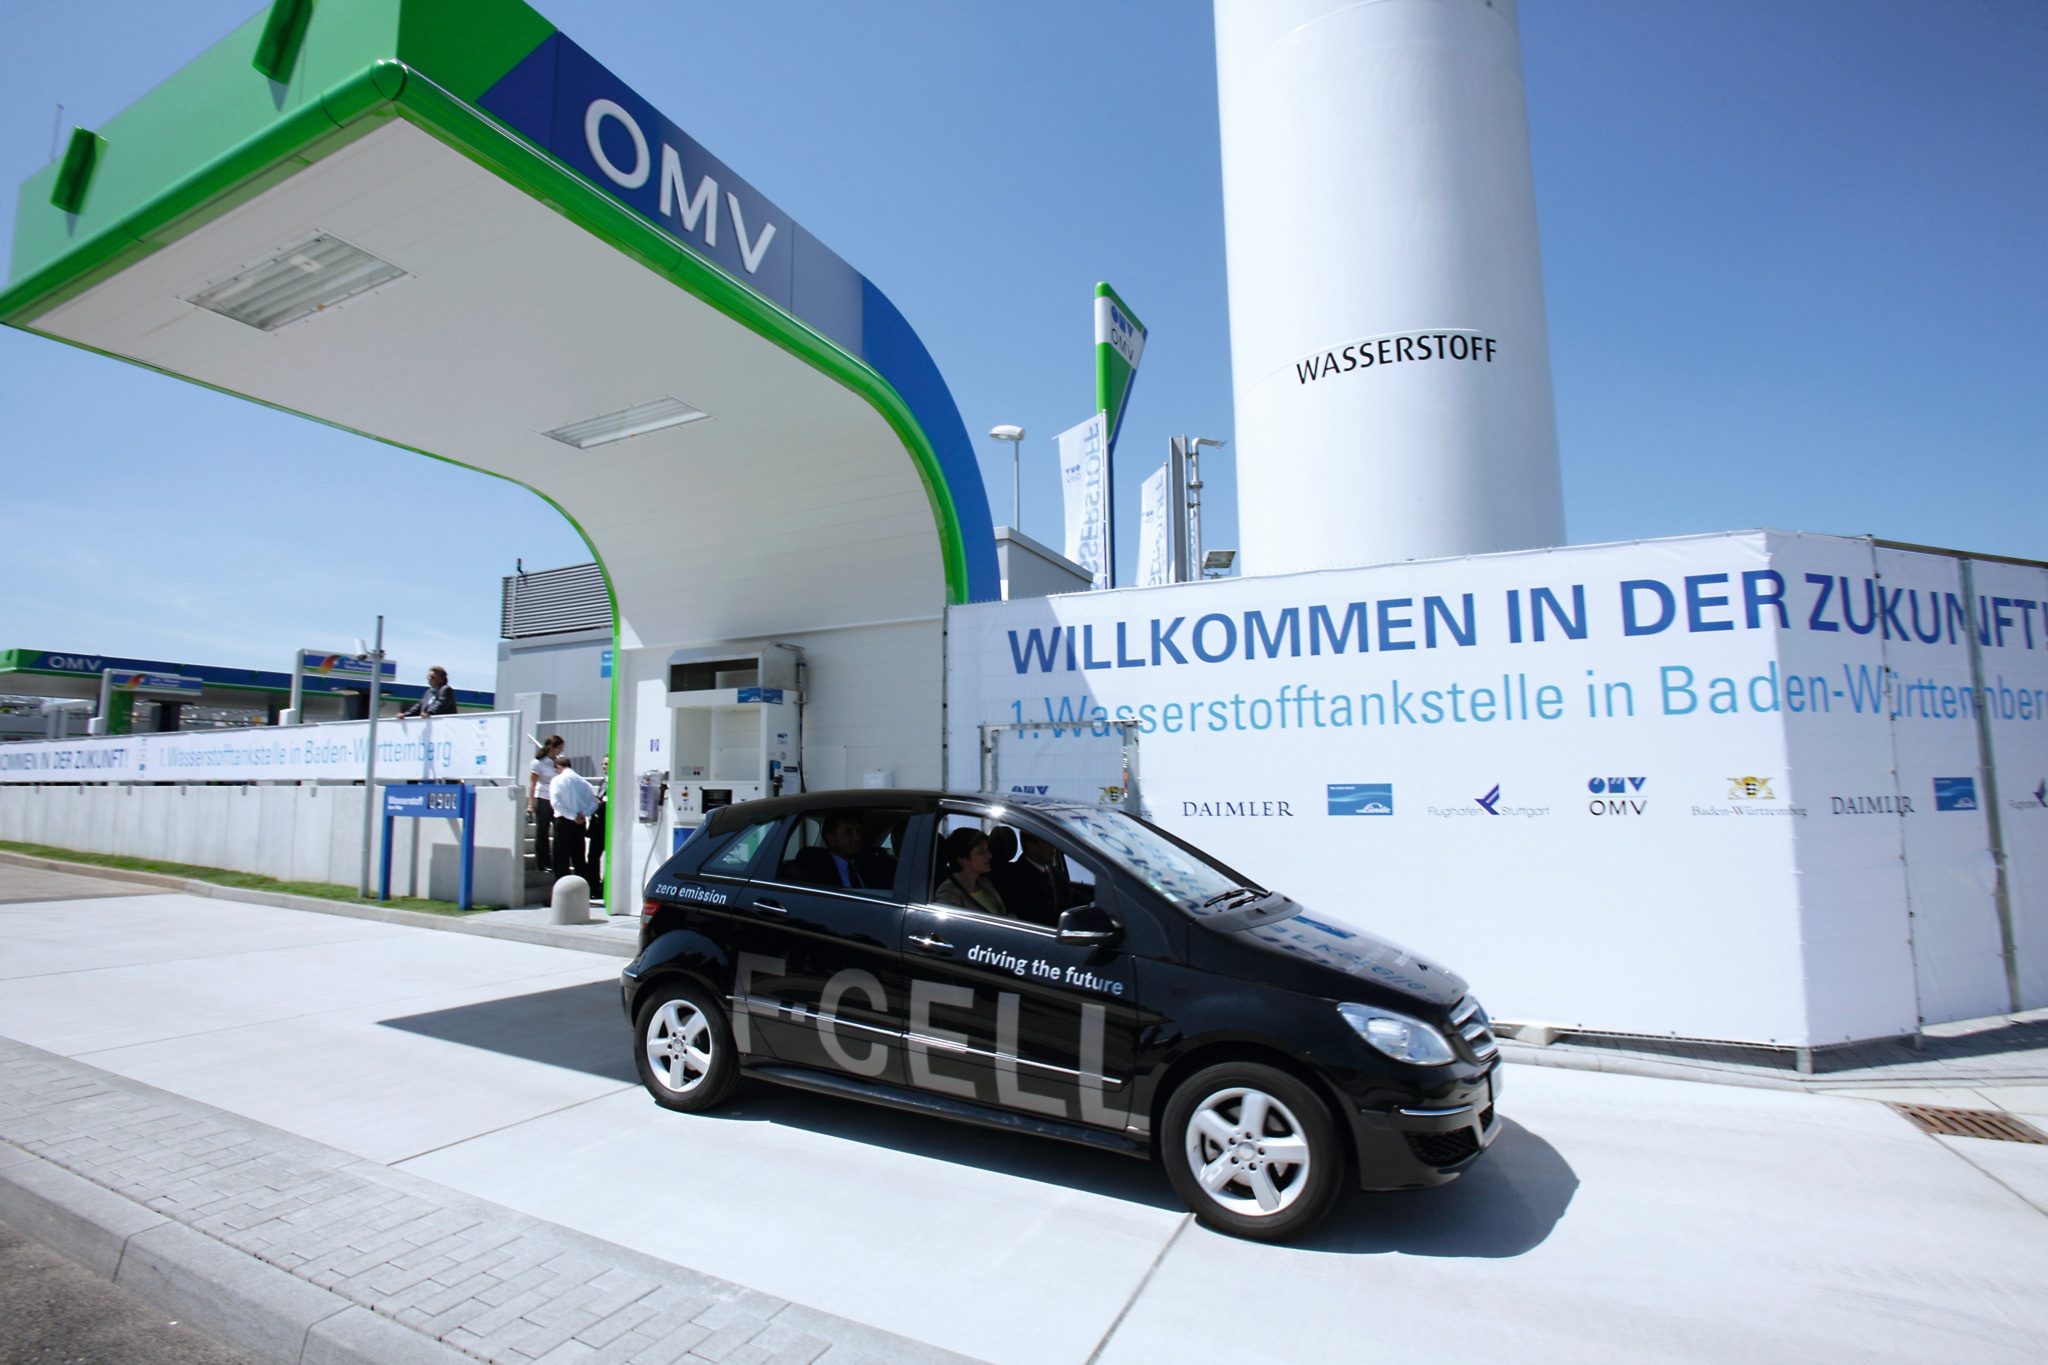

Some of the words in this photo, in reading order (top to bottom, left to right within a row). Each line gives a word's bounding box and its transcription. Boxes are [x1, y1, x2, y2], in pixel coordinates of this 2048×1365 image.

[584, 98, 777, 274] OMV
[1111, 328, 1134, 361] OMV
[1296, 335, 1497, 384] WASSERSTOFF
[1007, 592, 1477, 675] WILLKOMMEN
[1506, 584, 1588, 644] IN
[1620, 569, 1790, 637] DER
[48, 655, 102, 671] OMV
[1044, 673, 1565, 739] Wasserstofftankstelle
[1586, 669, 1634, 718] in
[305, 734, 452, 767] Baden-Wrttemberg
[1182, 801, 1294, 817] DAIMLER
[1427, 806, 1484, 818] Flughafen
[1501, 806, 1550, 818] Stuttgart
[1589, 800, 1647, 816] OMV
[655, 883, 677, 896] zero
[678, 886, 727, 905] emission
[967, 944, 1028, 976] driving
[1031, 959, 1061, 980] the
[1065, 966, 1124, 995] future
[732, 951, 1150, 1136] F-CELL
